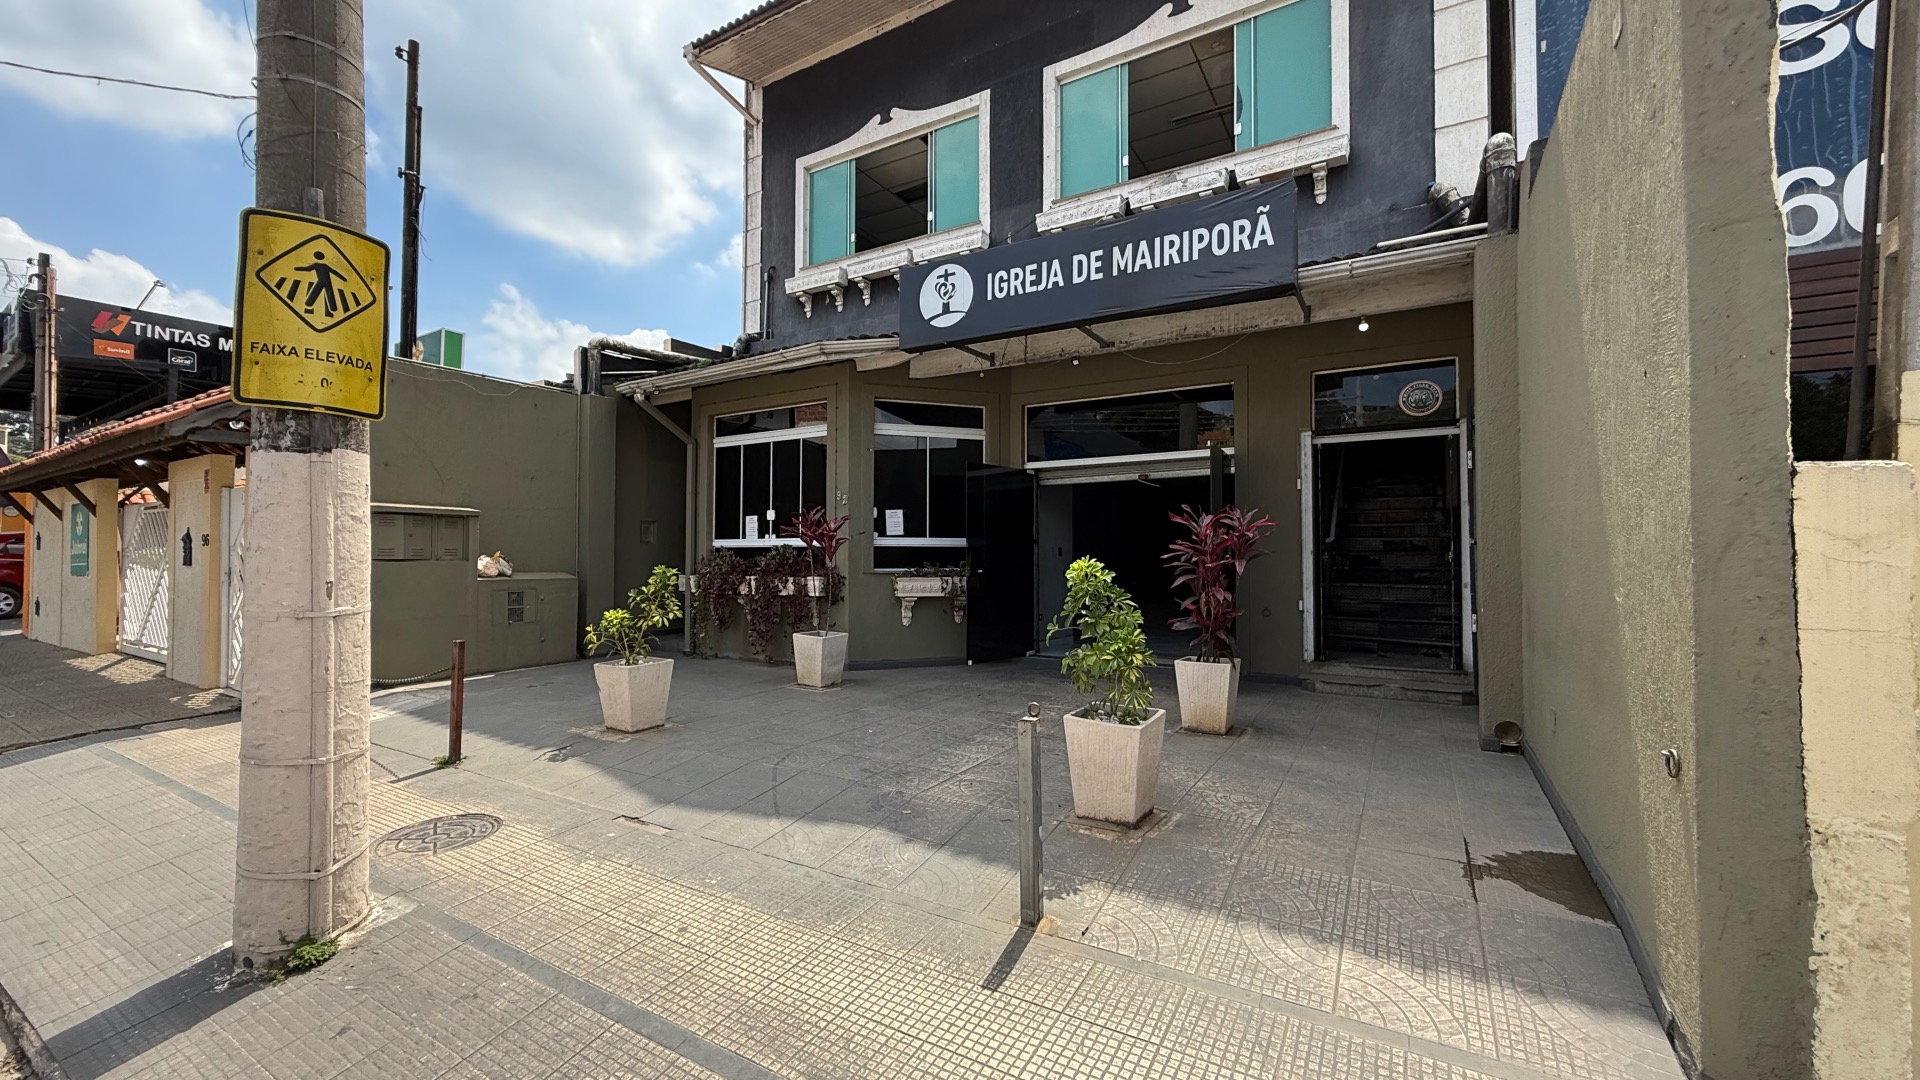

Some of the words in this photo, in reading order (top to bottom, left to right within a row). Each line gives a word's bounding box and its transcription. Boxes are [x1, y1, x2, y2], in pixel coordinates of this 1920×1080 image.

[986, 259, 1065, 301] IGREJA
[1072, 249, 1104, 285] DE
[1111, 204, 1275, 277] MAIRIPORÃ
[130, 320, 211, 347] TINTAS
[250, 341, 300, 358] FAIXA
[304, 347, 374, 373] ELEVADA
[201, 533, 210, 547] 96
